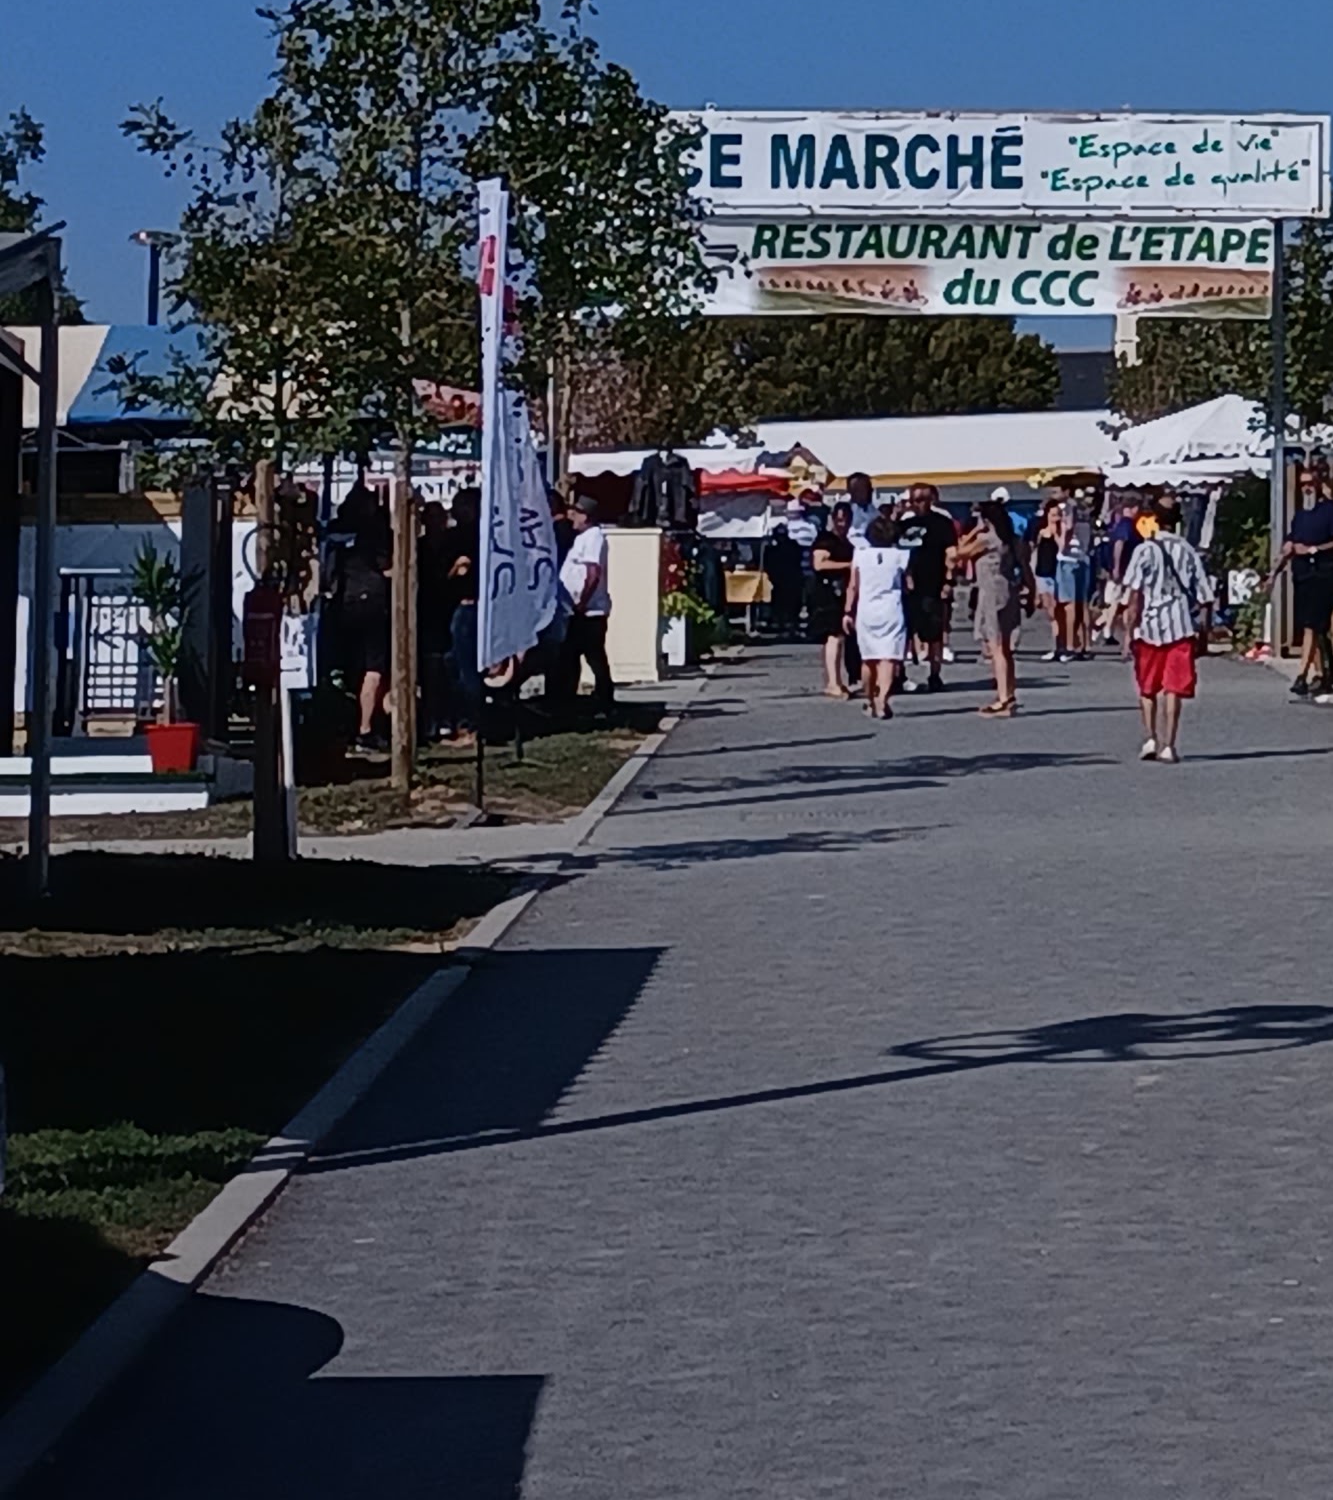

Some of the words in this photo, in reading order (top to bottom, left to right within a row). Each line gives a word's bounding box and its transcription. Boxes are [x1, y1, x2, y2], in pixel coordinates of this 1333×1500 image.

[770, 126, 1023, 189] MARCHÉ
[1192, 128, 1224, 154] de
[1164, 161, 1196, 187] de
[751, 224, 1042, 260] RESTAURANT
[1047, 224, 1100, 261] de
[1108, 225, 1272, 263] L'ETAPE
[942, 268, 1000, 306] du
[1011, 270, 1099, 307] CCC
